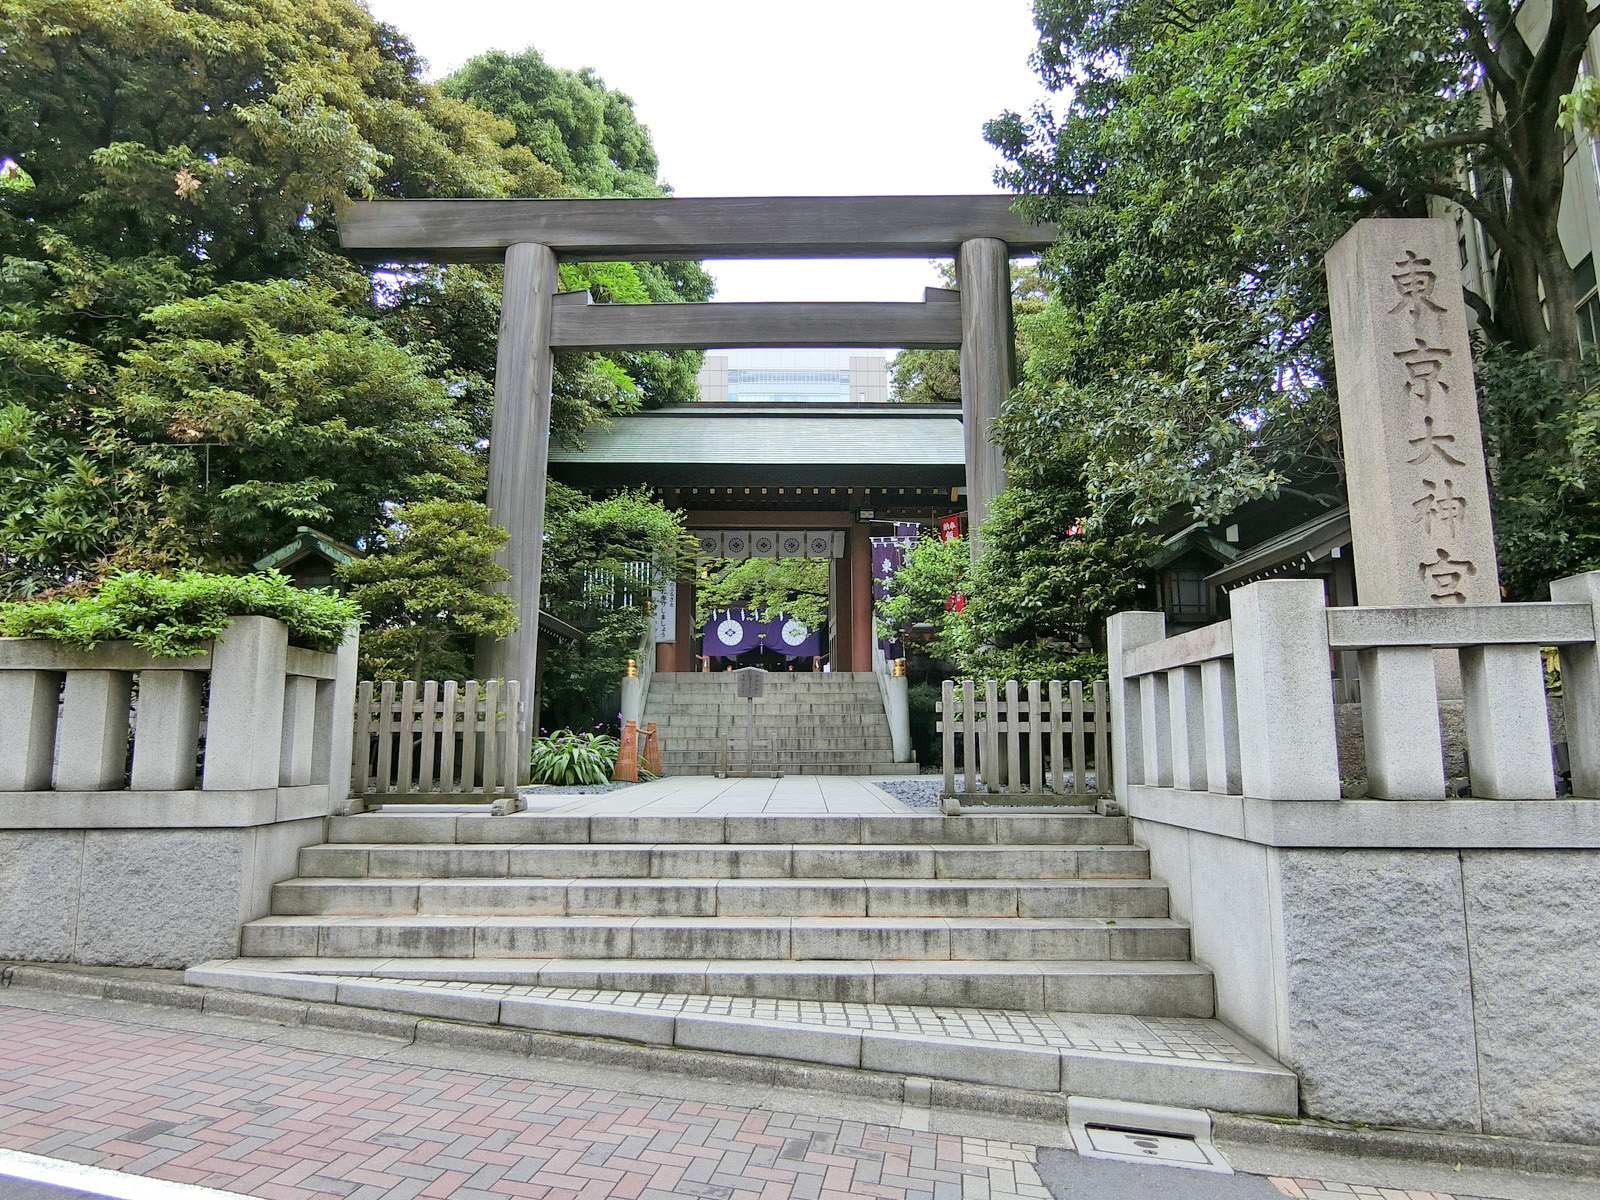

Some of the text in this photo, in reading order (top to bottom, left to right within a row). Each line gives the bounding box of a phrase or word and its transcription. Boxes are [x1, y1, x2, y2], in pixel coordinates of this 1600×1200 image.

[1388, 250, 1477, 605] 東京大神宮
